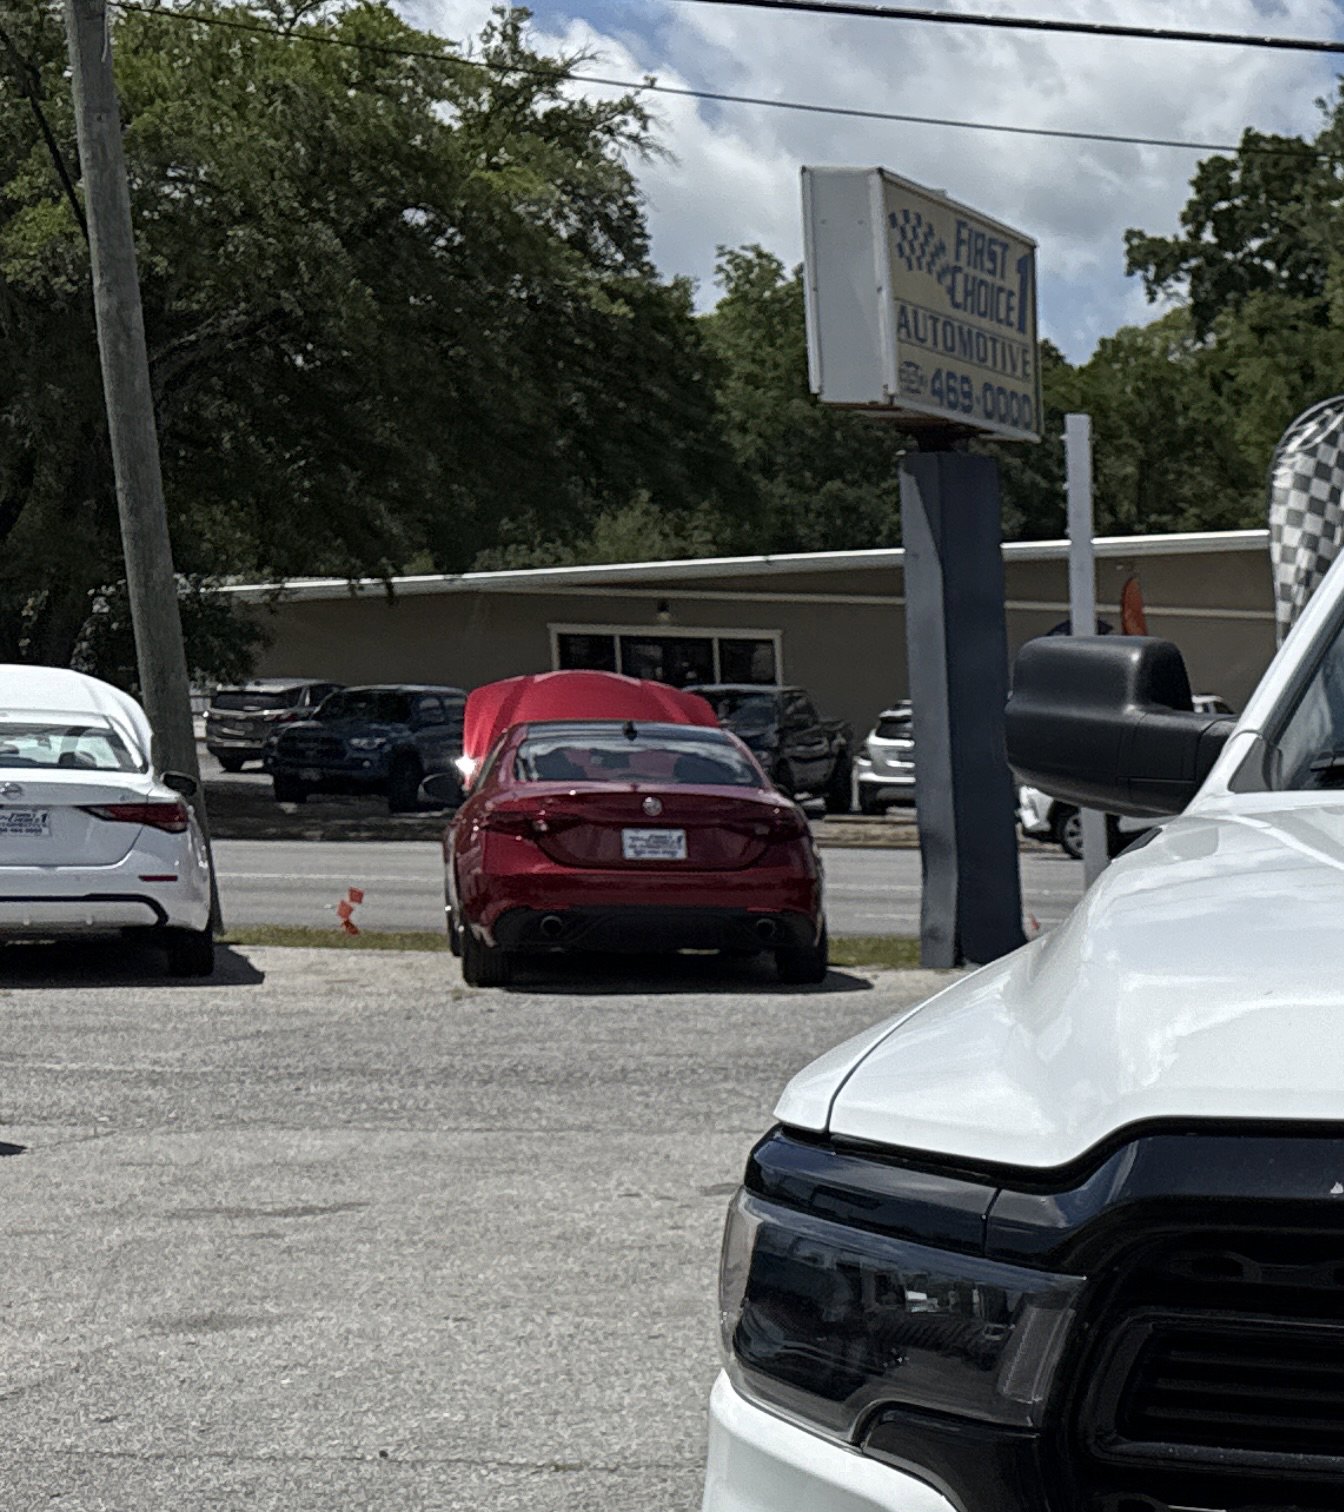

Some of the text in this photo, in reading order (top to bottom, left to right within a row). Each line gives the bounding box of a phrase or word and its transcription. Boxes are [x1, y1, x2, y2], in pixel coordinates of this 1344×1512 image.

[954, 219, 1009, 281] FIRST
[950, 265, 1016, 328] CHOICE
[1016, 255, 1032, 335] 1
[897, 305, 1031, 379] AUTOMOTIVE
[930, 367, 1033, 429] 469-0000
